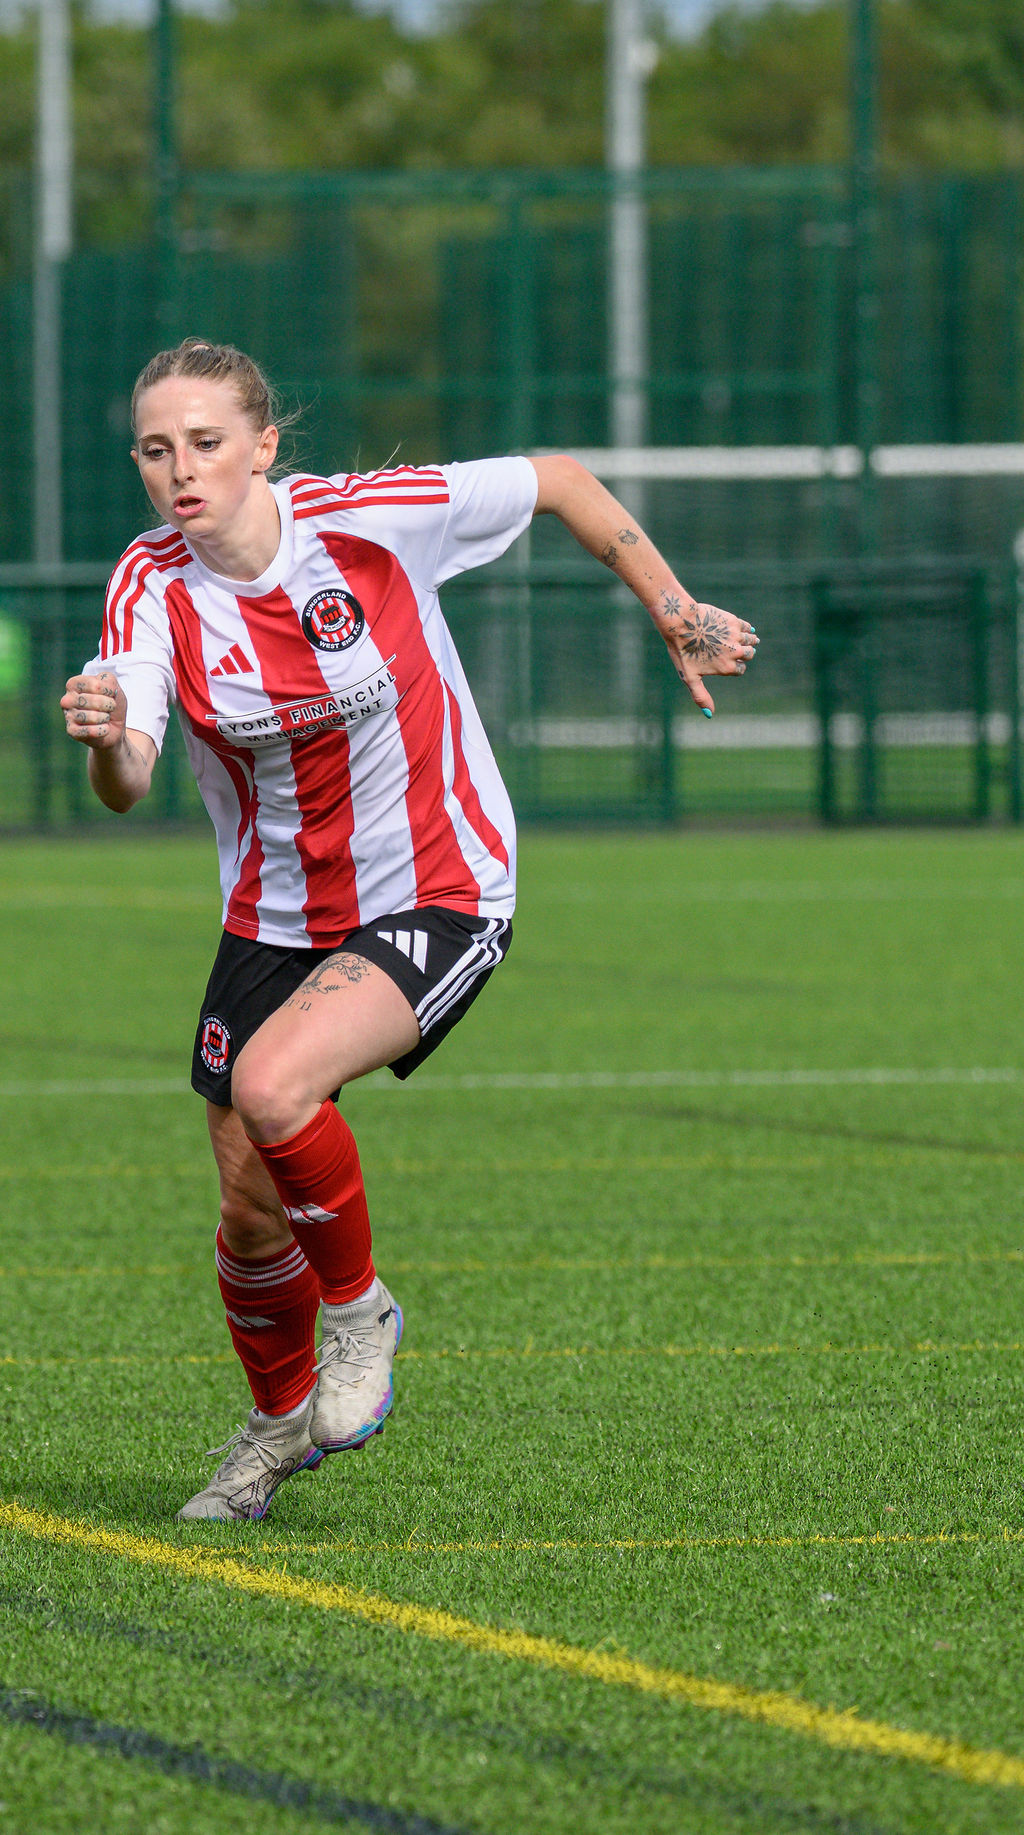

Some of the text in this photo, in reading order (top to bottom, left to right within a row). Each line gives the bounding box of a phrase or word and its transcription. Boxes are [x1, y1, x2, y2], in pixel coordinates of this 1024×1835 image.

[305, 591, 347, 617] SUNDERLAND
[319, 640, 340, 649] WEST
[341, 634, 355, 647] END
[218, 672, 397, 735] LYONS FINANCIAL
[246, 699, 383, 743] MANAGEMENT
